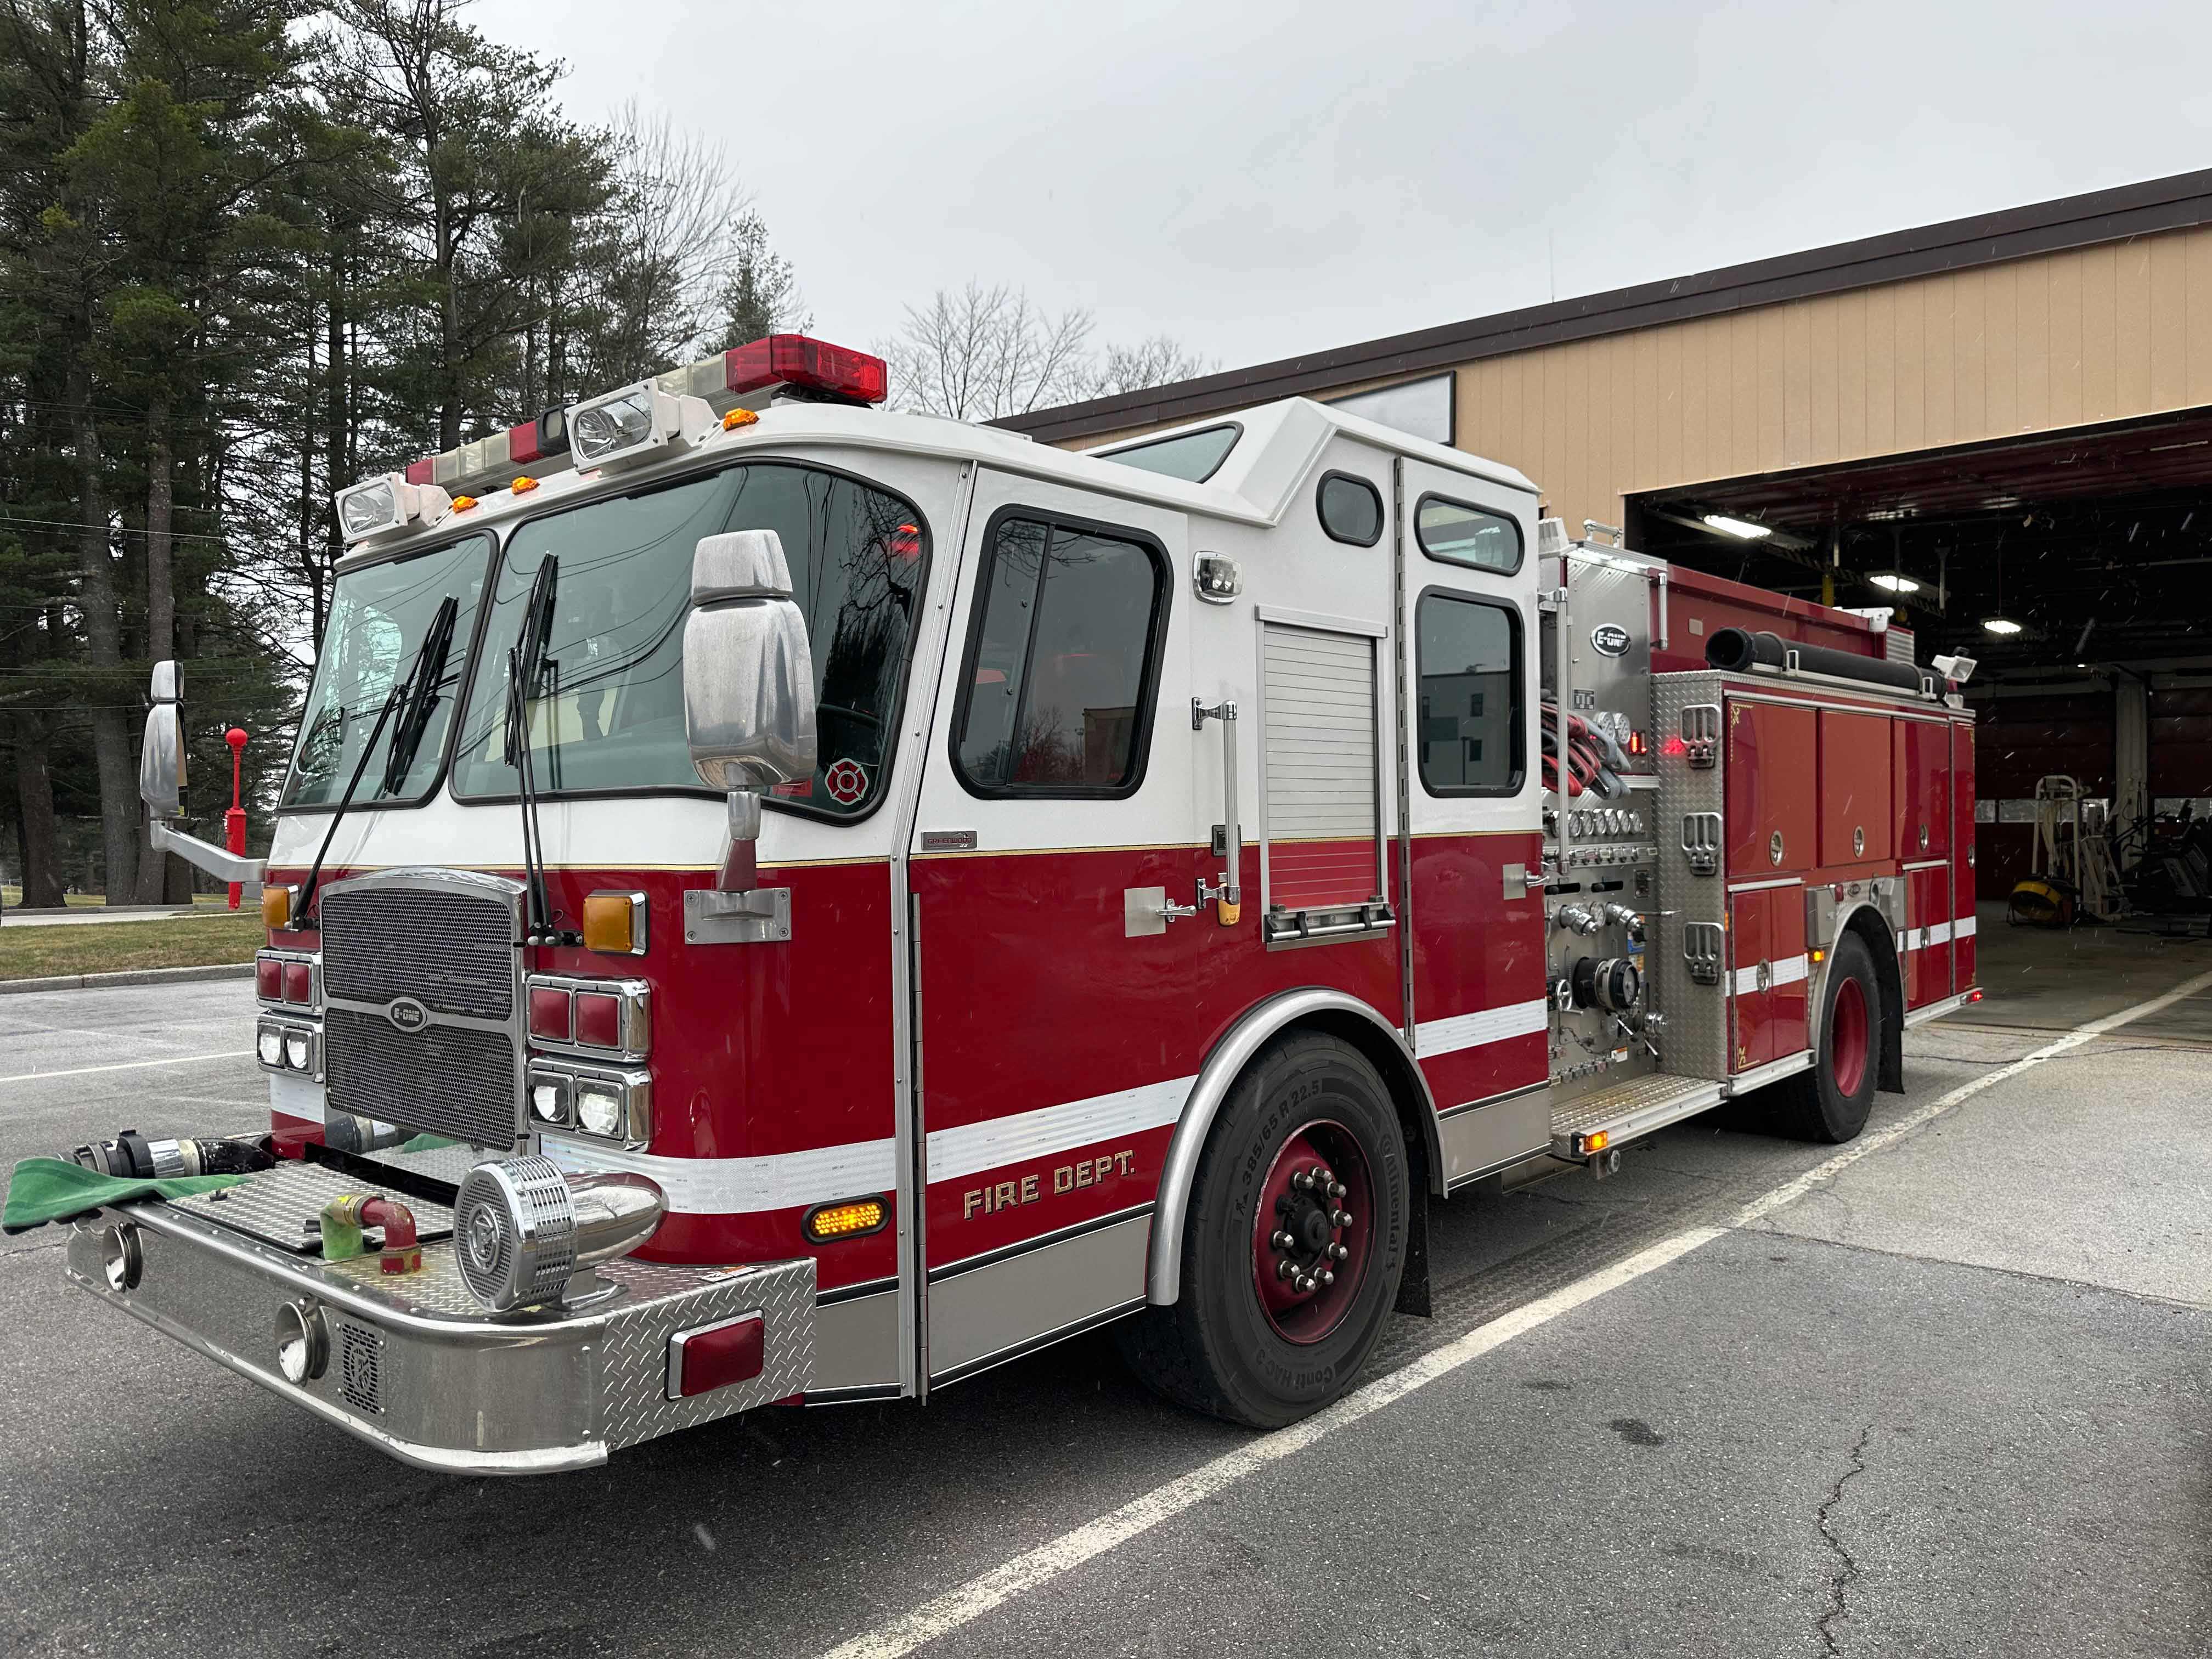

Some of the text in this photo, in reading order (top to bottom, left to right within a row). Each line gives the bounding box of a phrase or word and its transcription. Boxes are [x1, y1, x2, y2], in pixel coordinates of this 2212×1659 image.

[394, 1008, 420, 1022] E-ONE
[1243, 1113, 1279, 1186] 385/65
[1291, 1080, 1319, 1108] 22.5
[964, 1150, 1135, 1220] FIRE DEPT.
